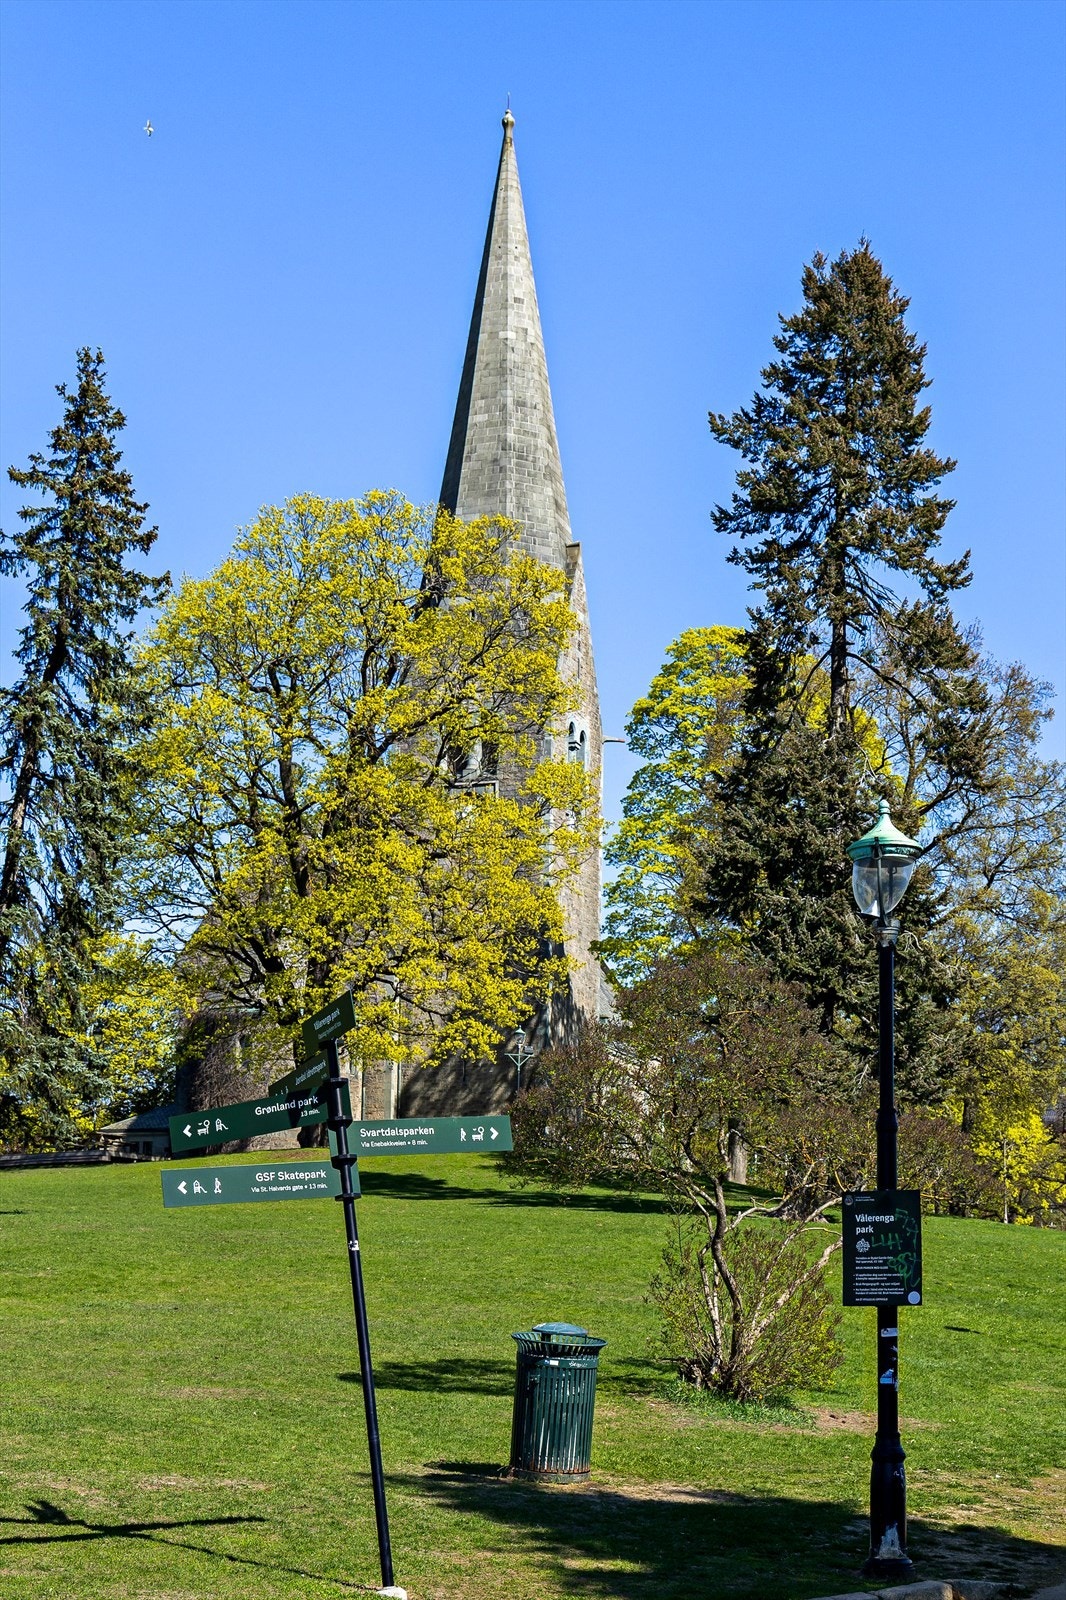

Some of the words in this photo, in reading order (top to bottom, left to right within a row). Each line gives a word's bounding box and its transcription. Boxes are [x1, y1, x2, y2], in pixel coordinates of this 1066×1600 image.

[255, 1099, 296, 1115] Grønland
[297, 1095, 319, 1109] park
[300, 1109, 308, 1117] 13
[359, 1126, 435, 1138] Svartdalsparken
[255, 1172, 276, 1182] GSF
[277, 1169, 327, 1181] Skatepark
[260, 1185, 268, 1193] St.
[292, 1184, 304, 1192] gate
[316, 1182, 328, 1190] min.
[855, 1214, 894, 1224] Vålerenga
[856, 1225, 874, 1235] park
